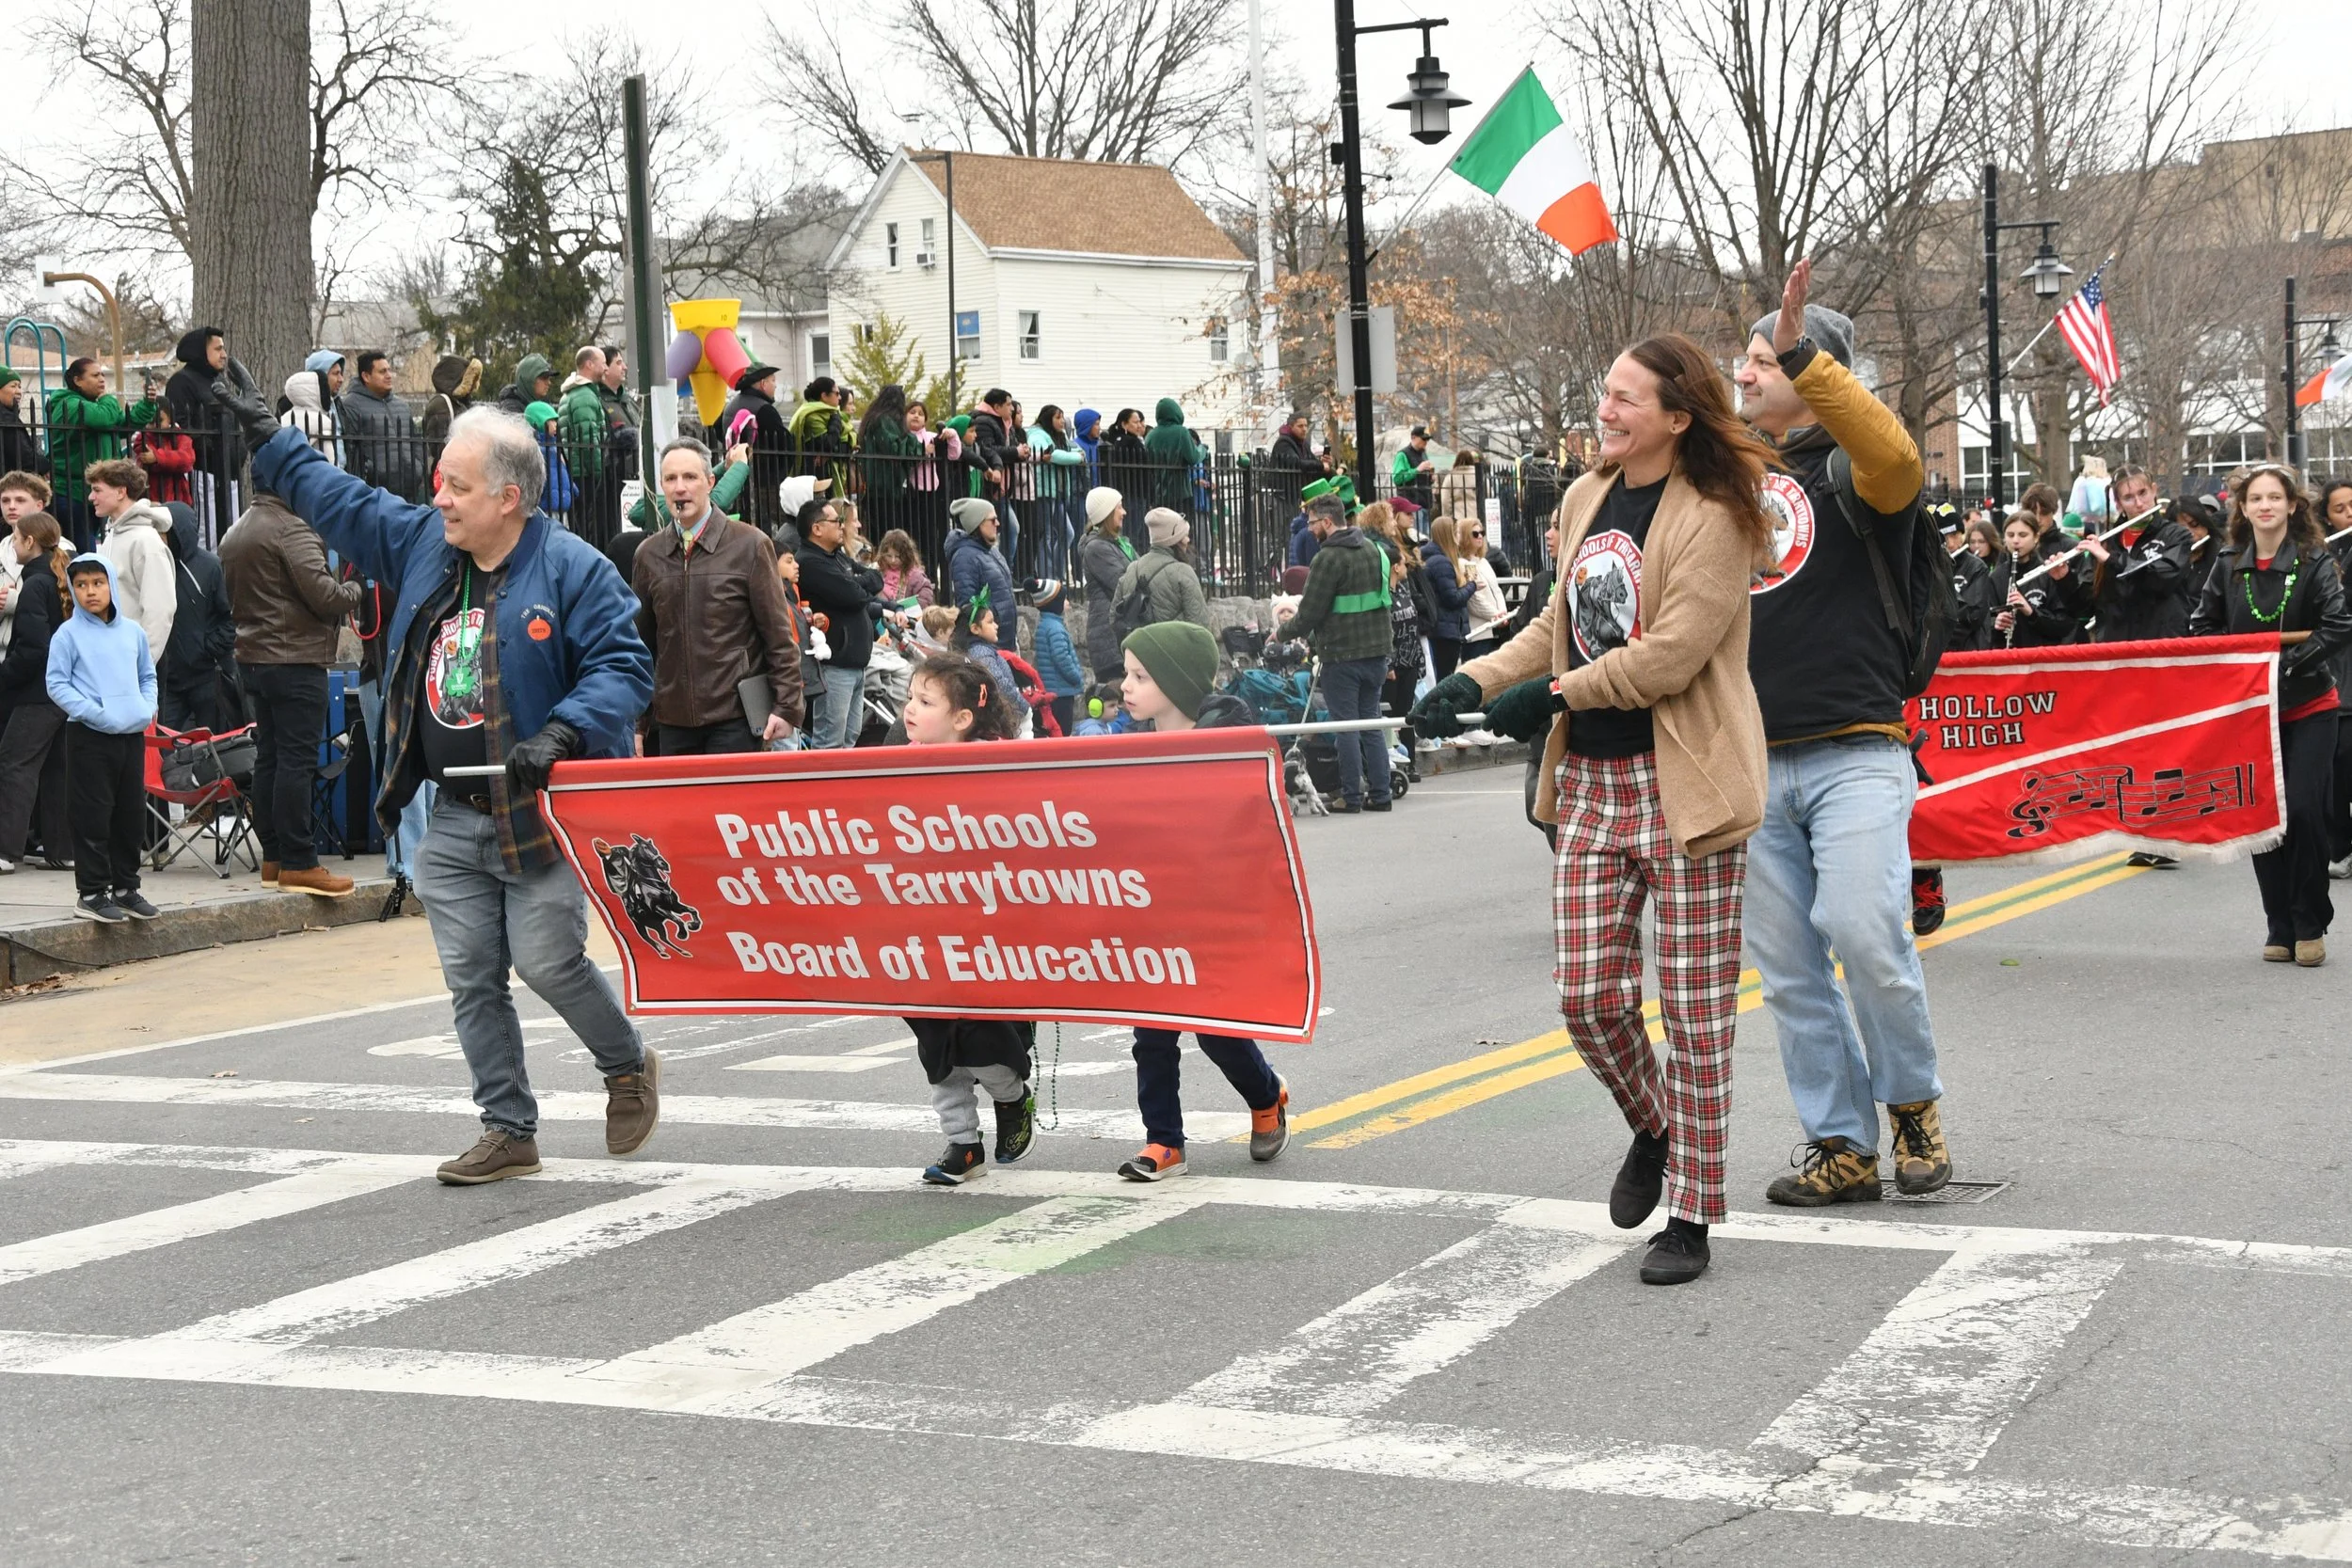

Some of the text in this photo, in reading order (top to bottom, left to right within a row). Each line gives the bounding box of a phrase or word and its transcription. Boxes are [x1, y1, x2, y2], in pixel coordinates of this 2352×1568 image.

[1570, 537, 1607, 573] HOOLS
[429, 643, 443, 682] PUBLIC
[441, 614, 470, 639] CHOLS
[1918, 691, 2057, 721] HOLLOW
[1941, 722, 2025, 750] HIGH
[714, 800, 1097, 859] Public Schools
[716, 861, 1152, 915] of the Tarrytowns
[725, 931, 1197, 986] Board of Education
